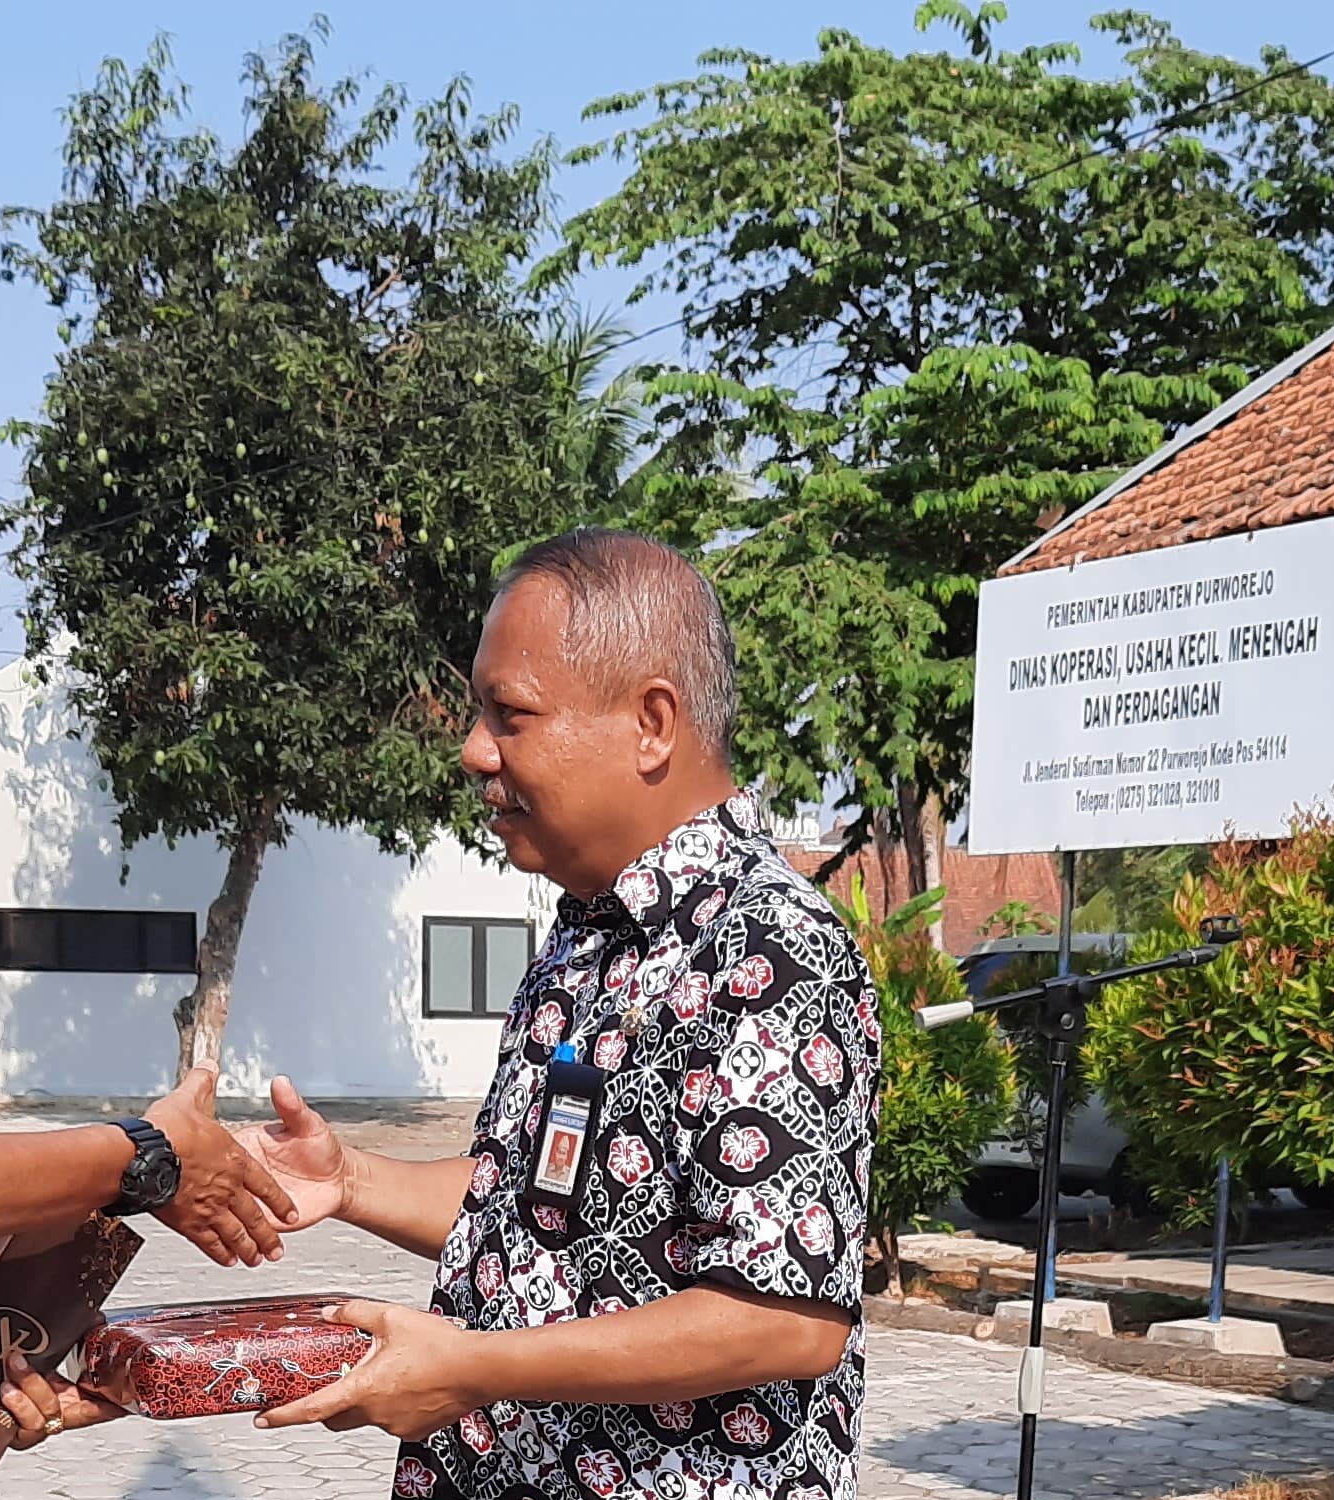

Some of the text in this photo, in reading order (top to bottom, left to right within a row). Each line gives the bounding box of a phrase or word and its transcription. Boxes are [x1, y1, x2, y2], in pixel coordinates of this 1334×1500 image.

[1047, 570, 1274, 629] PEMERINTAH KABUPATEN PURWOREJO
[1010, 655, 1046, 691] DINAS
[1050, 645, 1121, 684] KOPERASI,
[1126, 638, 1173, 675] USAHA
[1228, 616, 1318, 662] MENENGAH
[1083, 681, 1222, 729] DAN PERDAGANGAN
[1035, 757, 1071, 782] Jenderal
[1073, 755, 1113, 777] Sudirman
[1117, 752, 1145, 774] Nomor
[1147, 749, 1159, 771] 22
[1161, 744, 1207, 773] Purworejo
[1210, 742, 1233, 766] Kode
[1236, 740, 1253, 763] Pos
[1256, 735, 1287, 761] 54114
[1076, 790, 1109, 816] Telepon
[1116, 785, 1145, 814] (0275)
[1186, 778, 1220, 804] 321018
